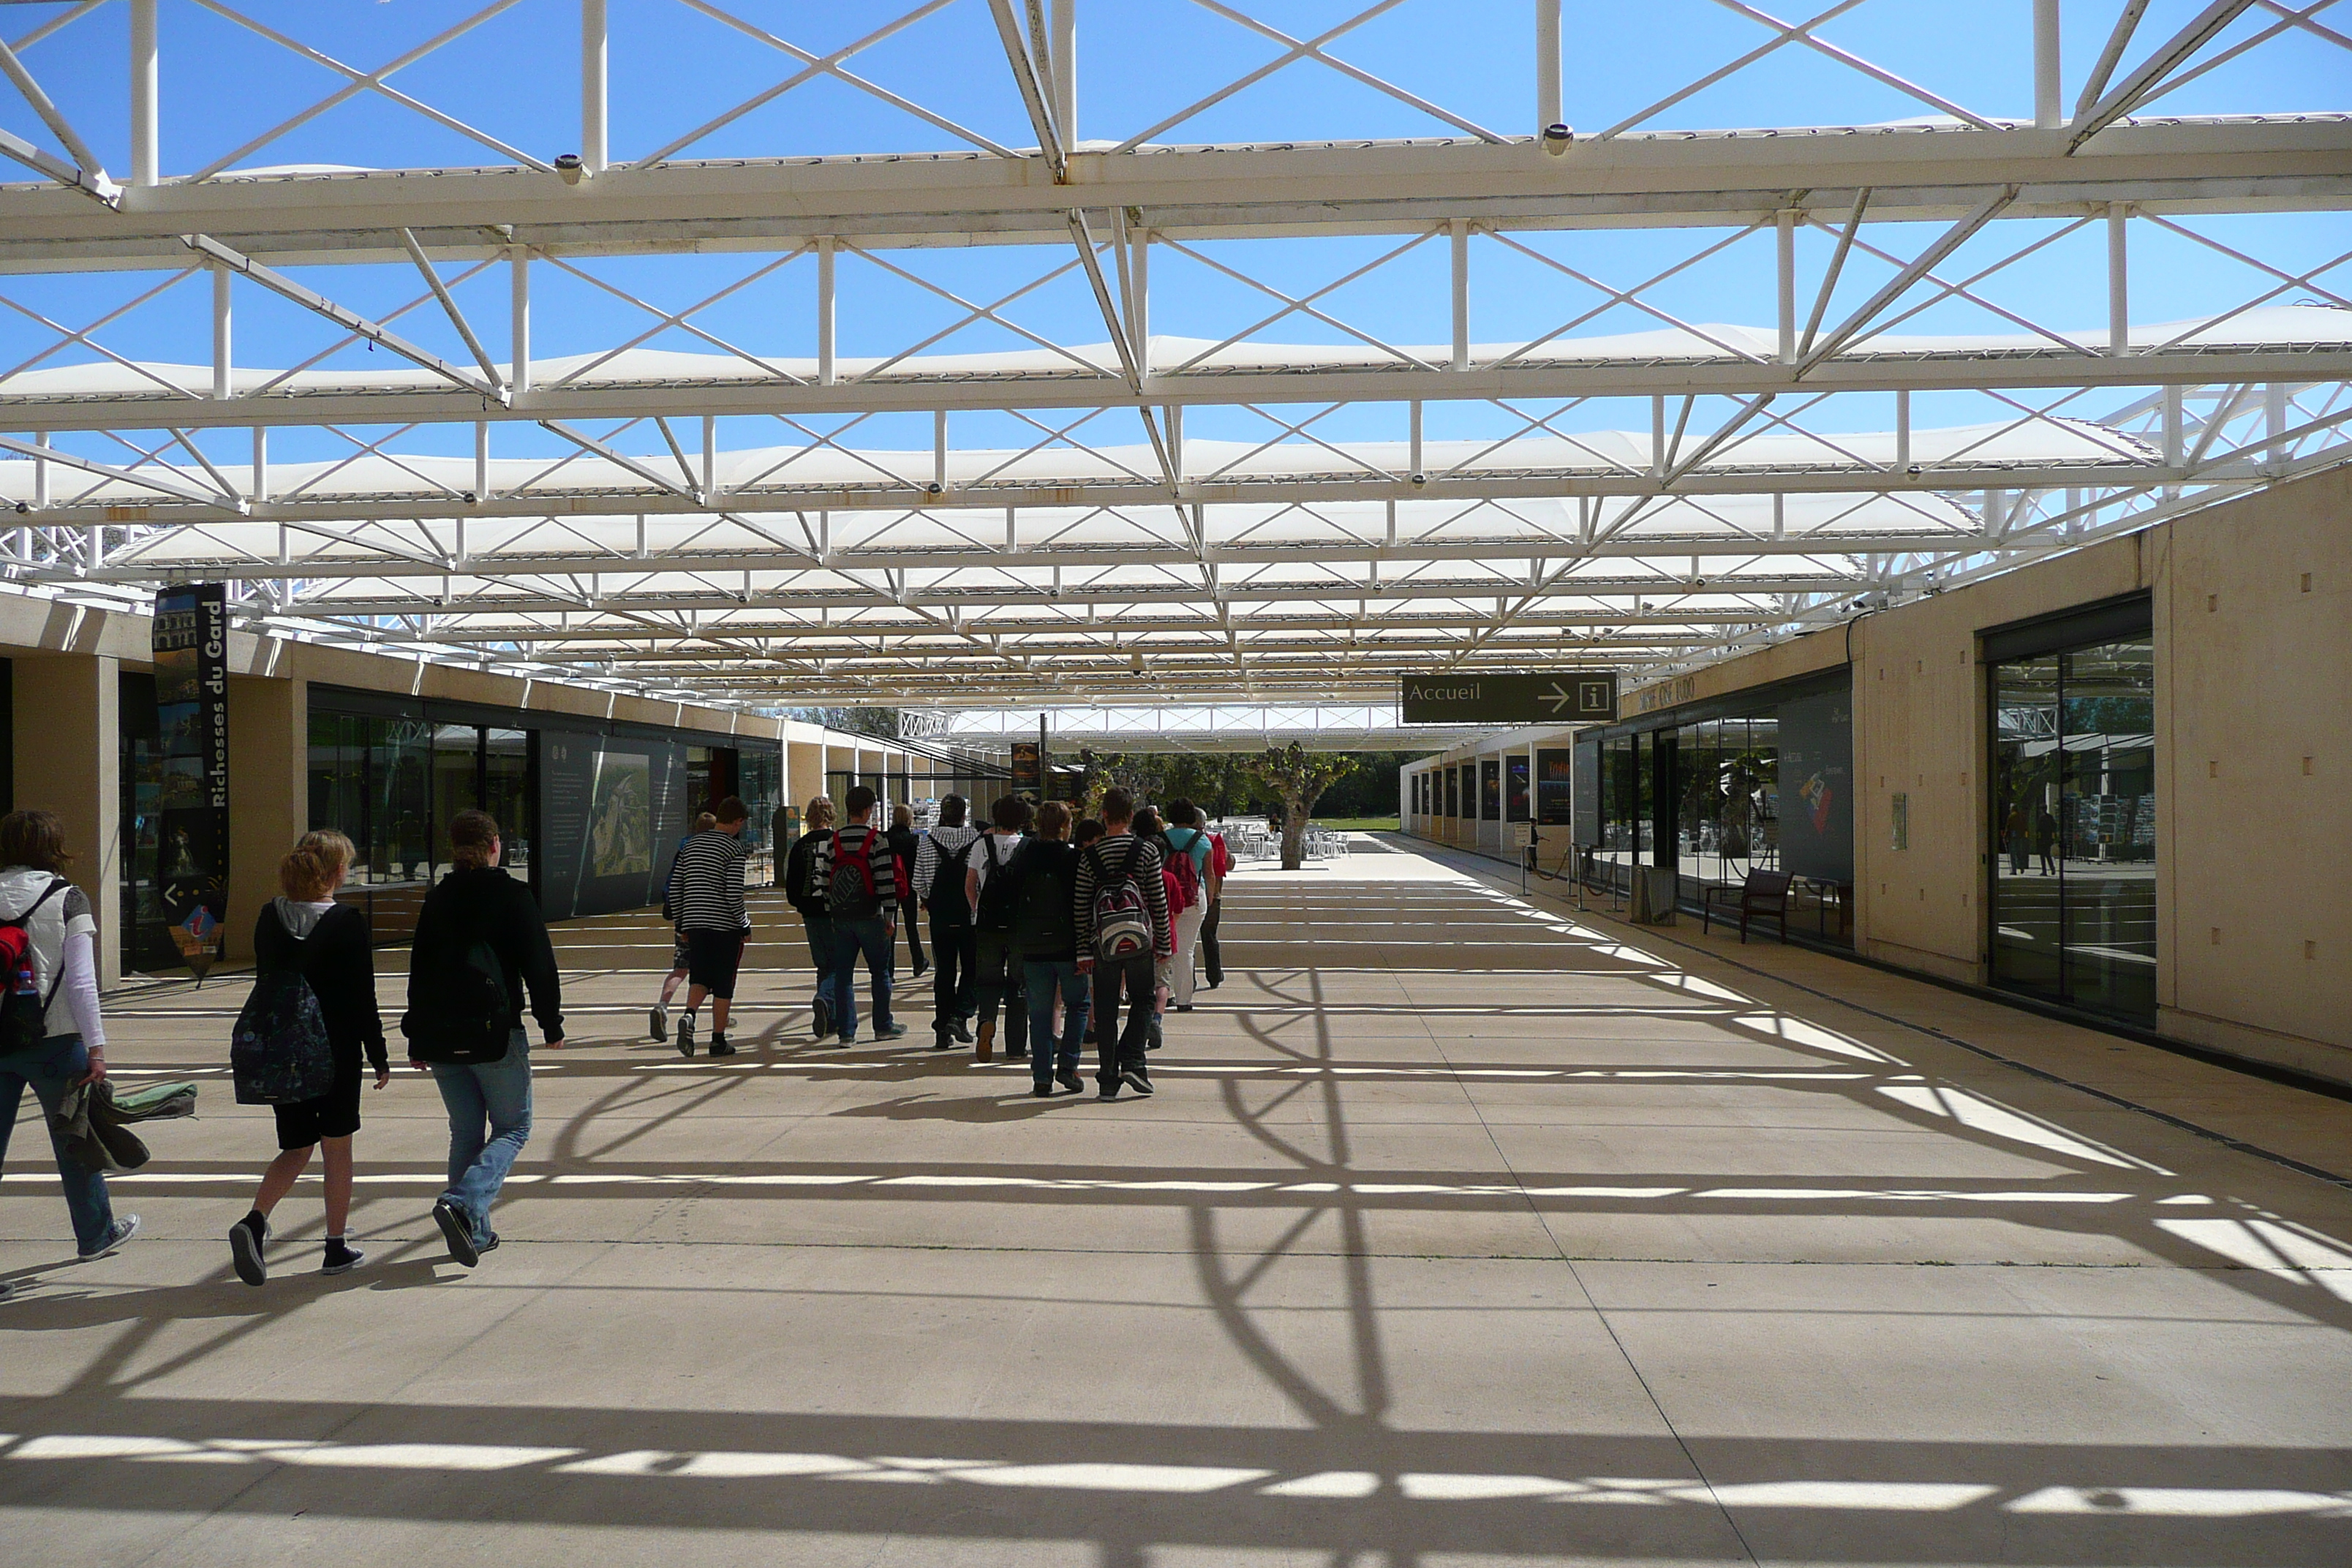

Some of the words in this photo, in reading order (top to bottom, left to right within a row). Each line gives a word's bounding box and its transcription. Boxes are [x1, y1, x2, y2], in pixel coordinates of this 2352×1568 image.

[202, 601, 222, 658] Gard
[206, 666, 224, 695] du
[1409, 682, 1480, 701] Accueil
[209, 702, 226, 807] Richesses
[830, 865, 862, 906] NIKE
